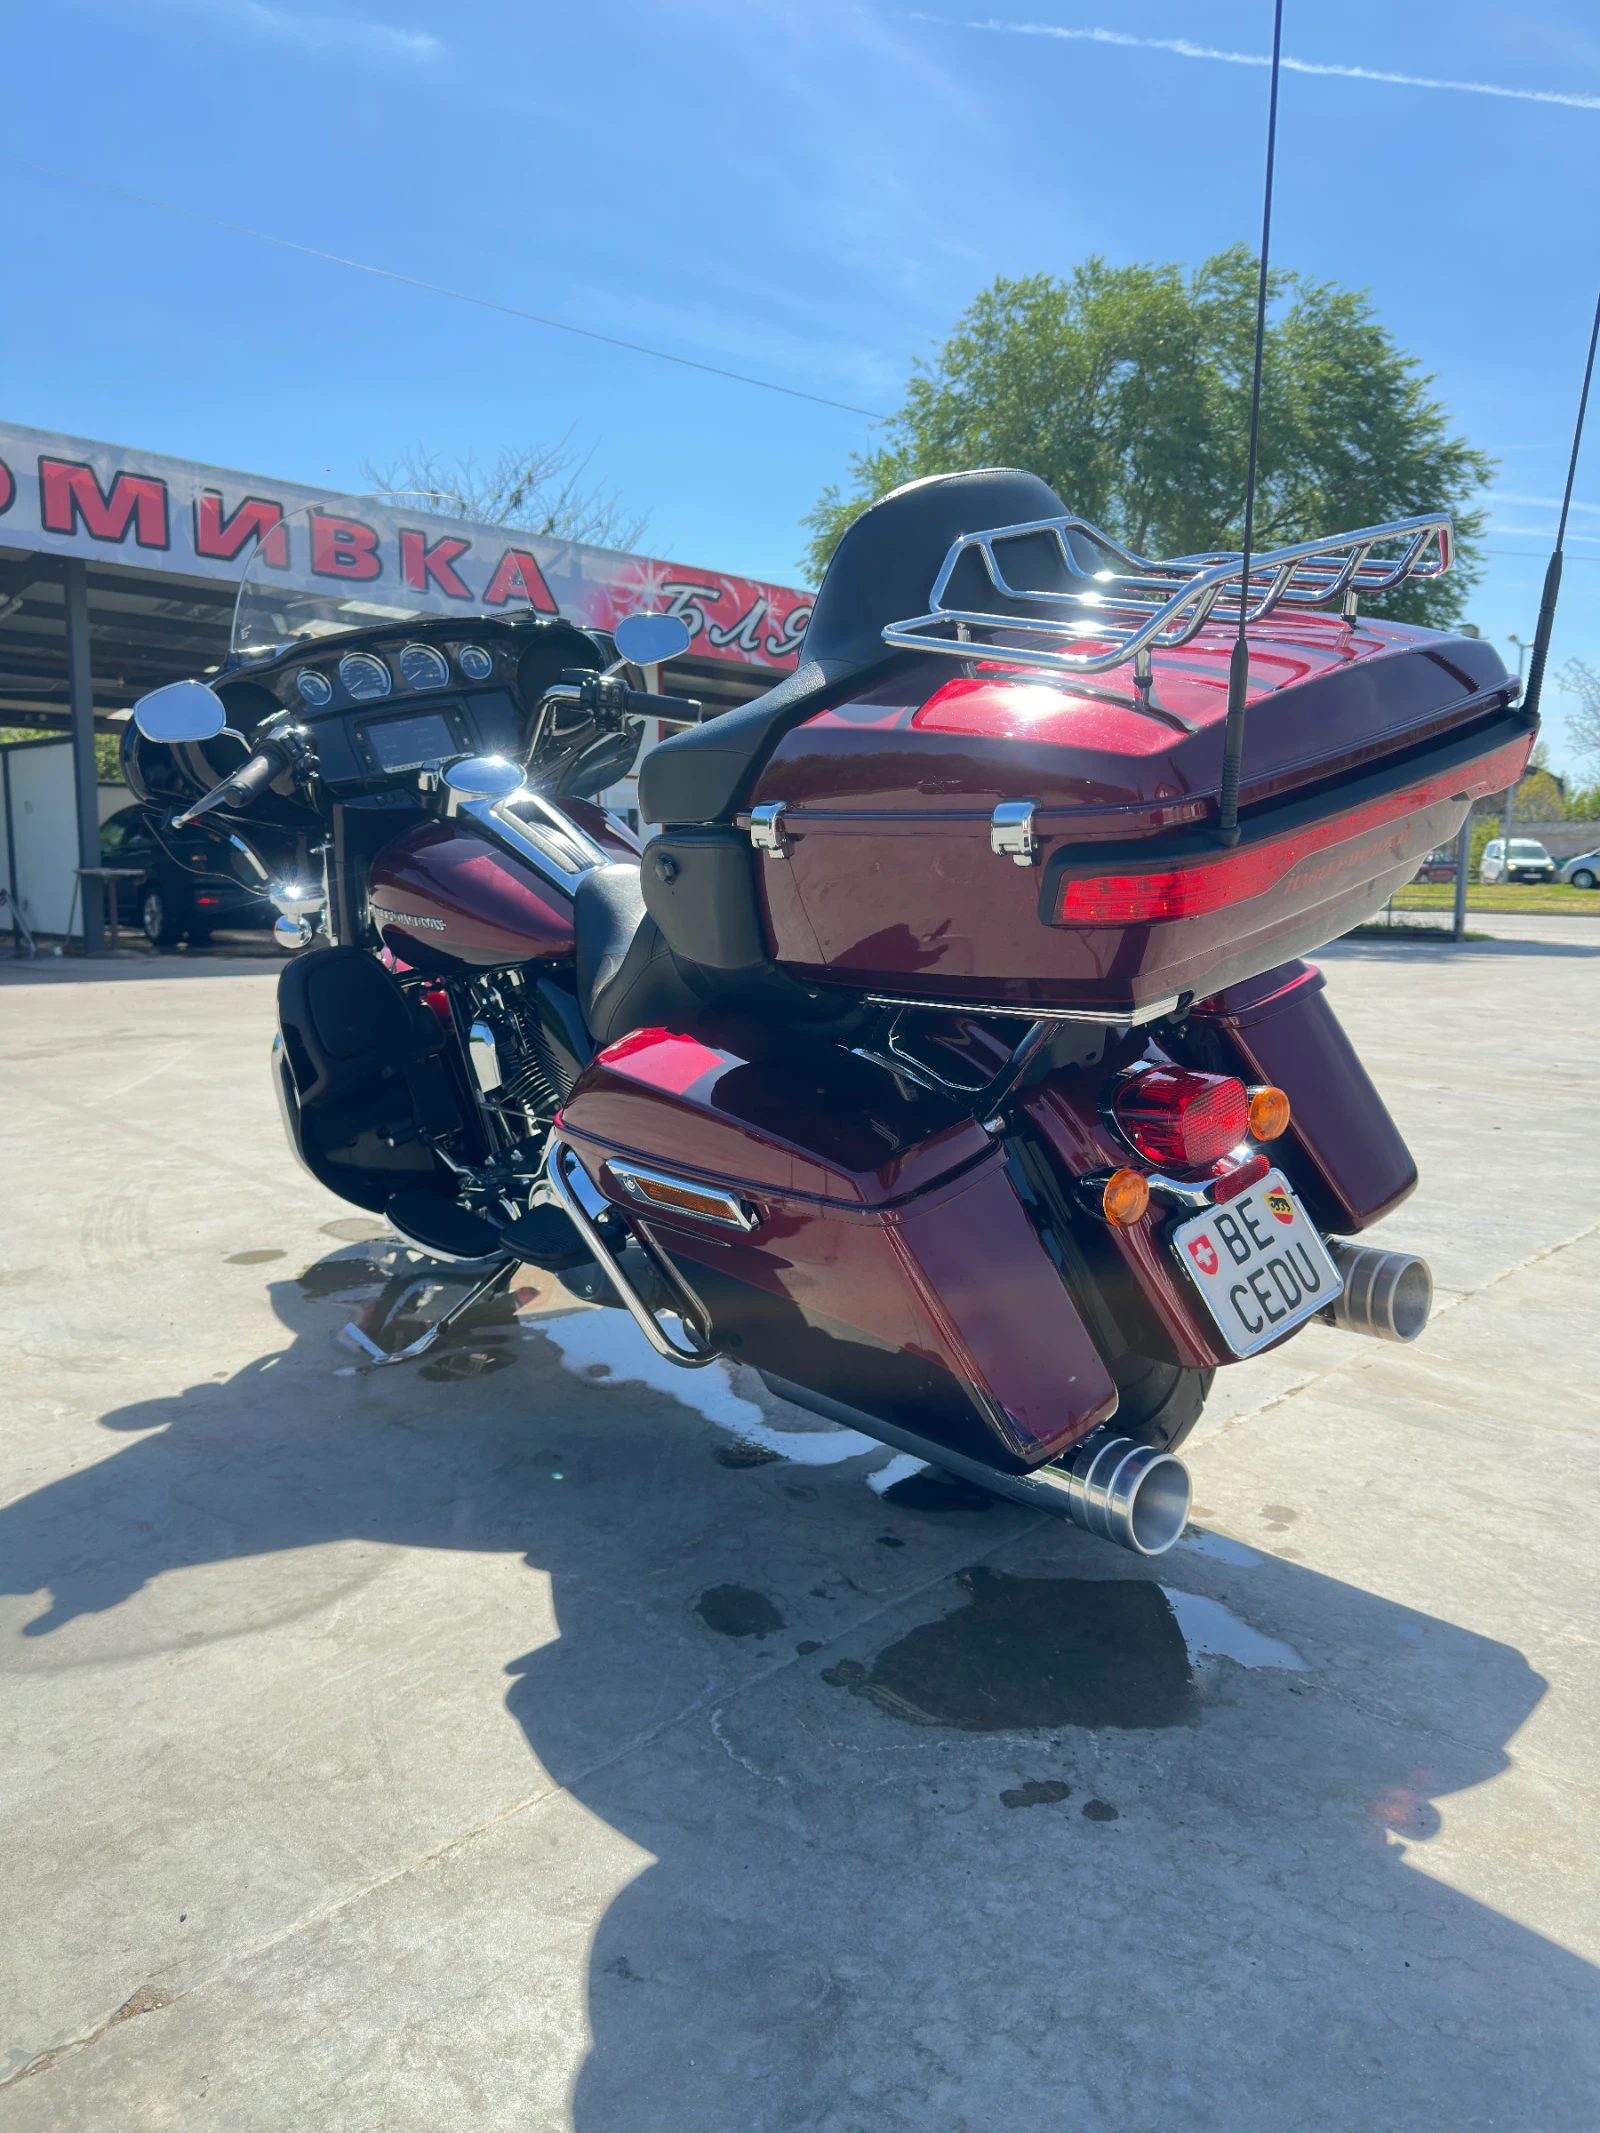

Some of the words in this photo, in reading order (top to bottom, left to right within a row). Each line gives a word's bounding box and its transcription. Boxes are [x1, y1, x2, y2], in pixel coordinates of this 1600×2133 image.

[0, 455, 559, 615] МИВКА
[1213, 1197, 1275, 1266] BE
[1229, 1242, 1321, 1334] CEDU
